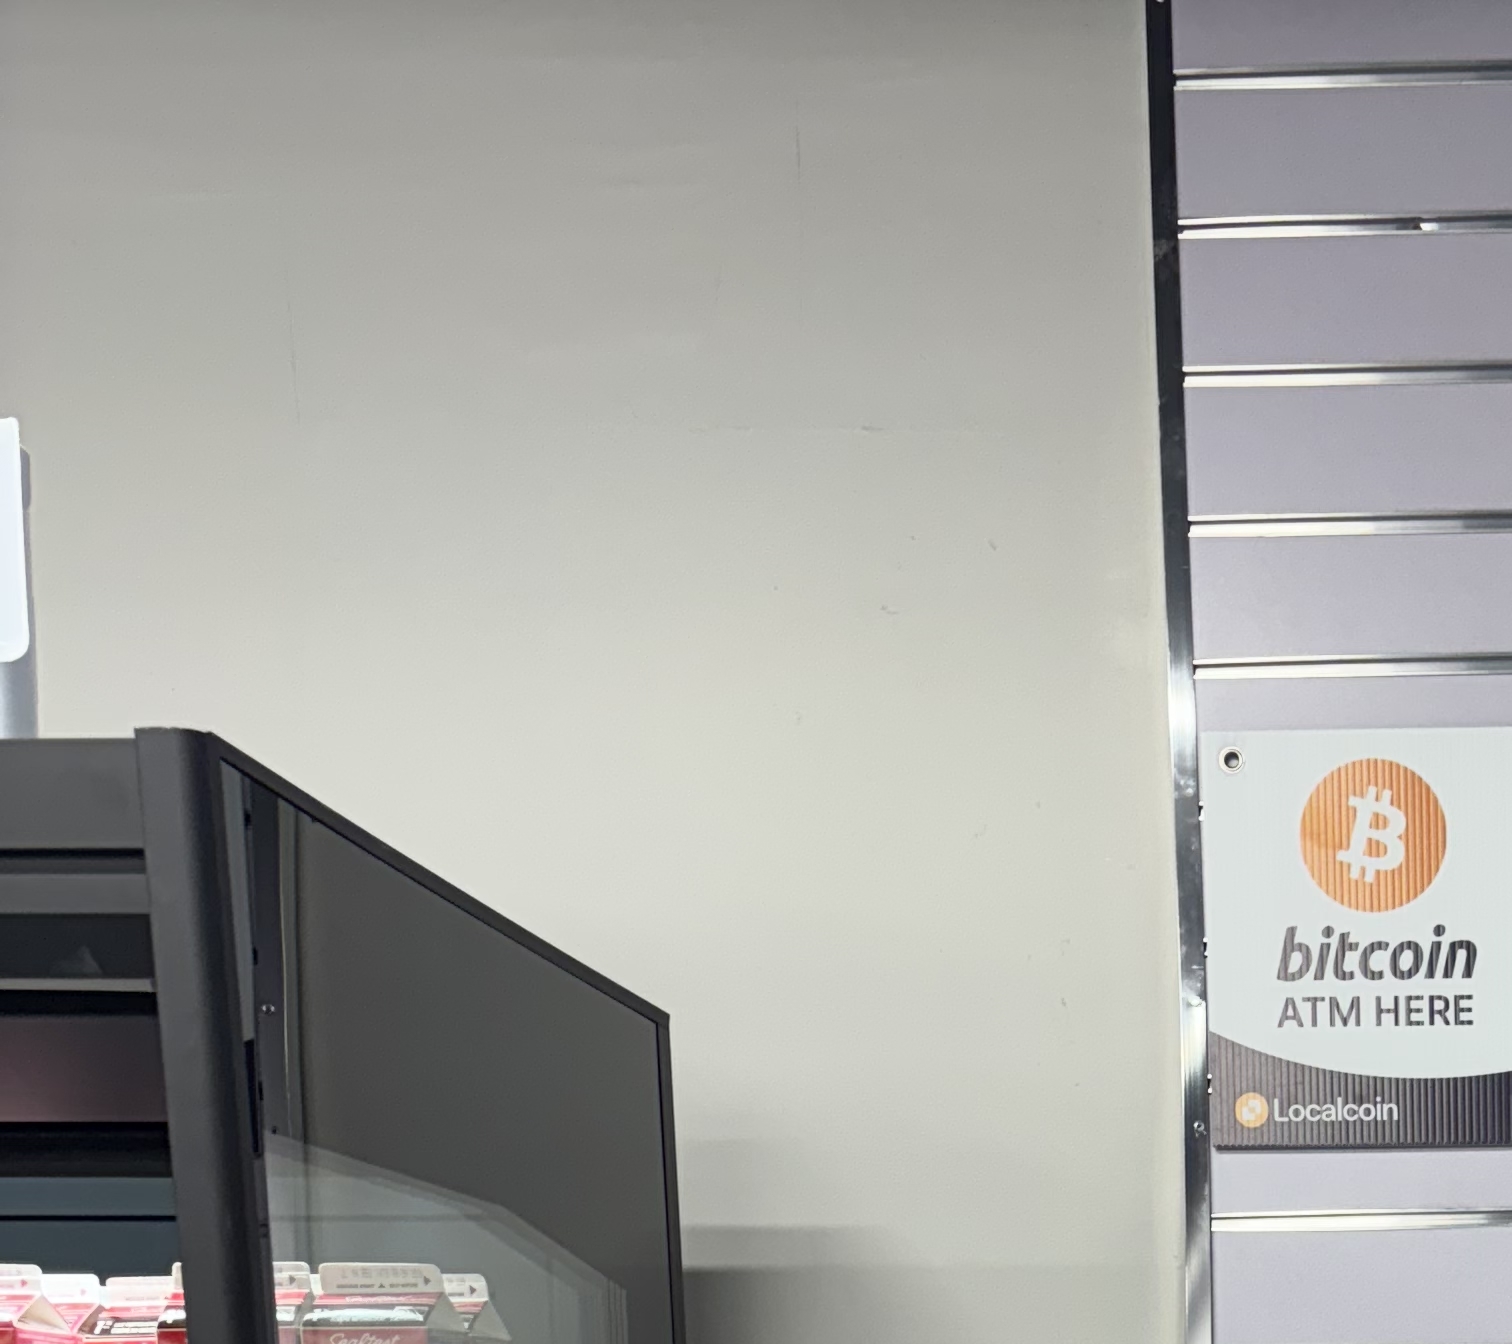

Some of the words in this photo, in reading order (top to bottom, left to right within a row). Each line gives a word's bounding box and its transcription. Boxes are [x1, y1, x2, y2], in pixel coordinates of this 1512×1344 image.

[1276, 924, 1478, 982] bitcoin
[1277, 995, 1361, 1028] ATM
[1375, 994, 1475, 1027] HERE
[1273, 1097, 1399, 1123] Localcoin
